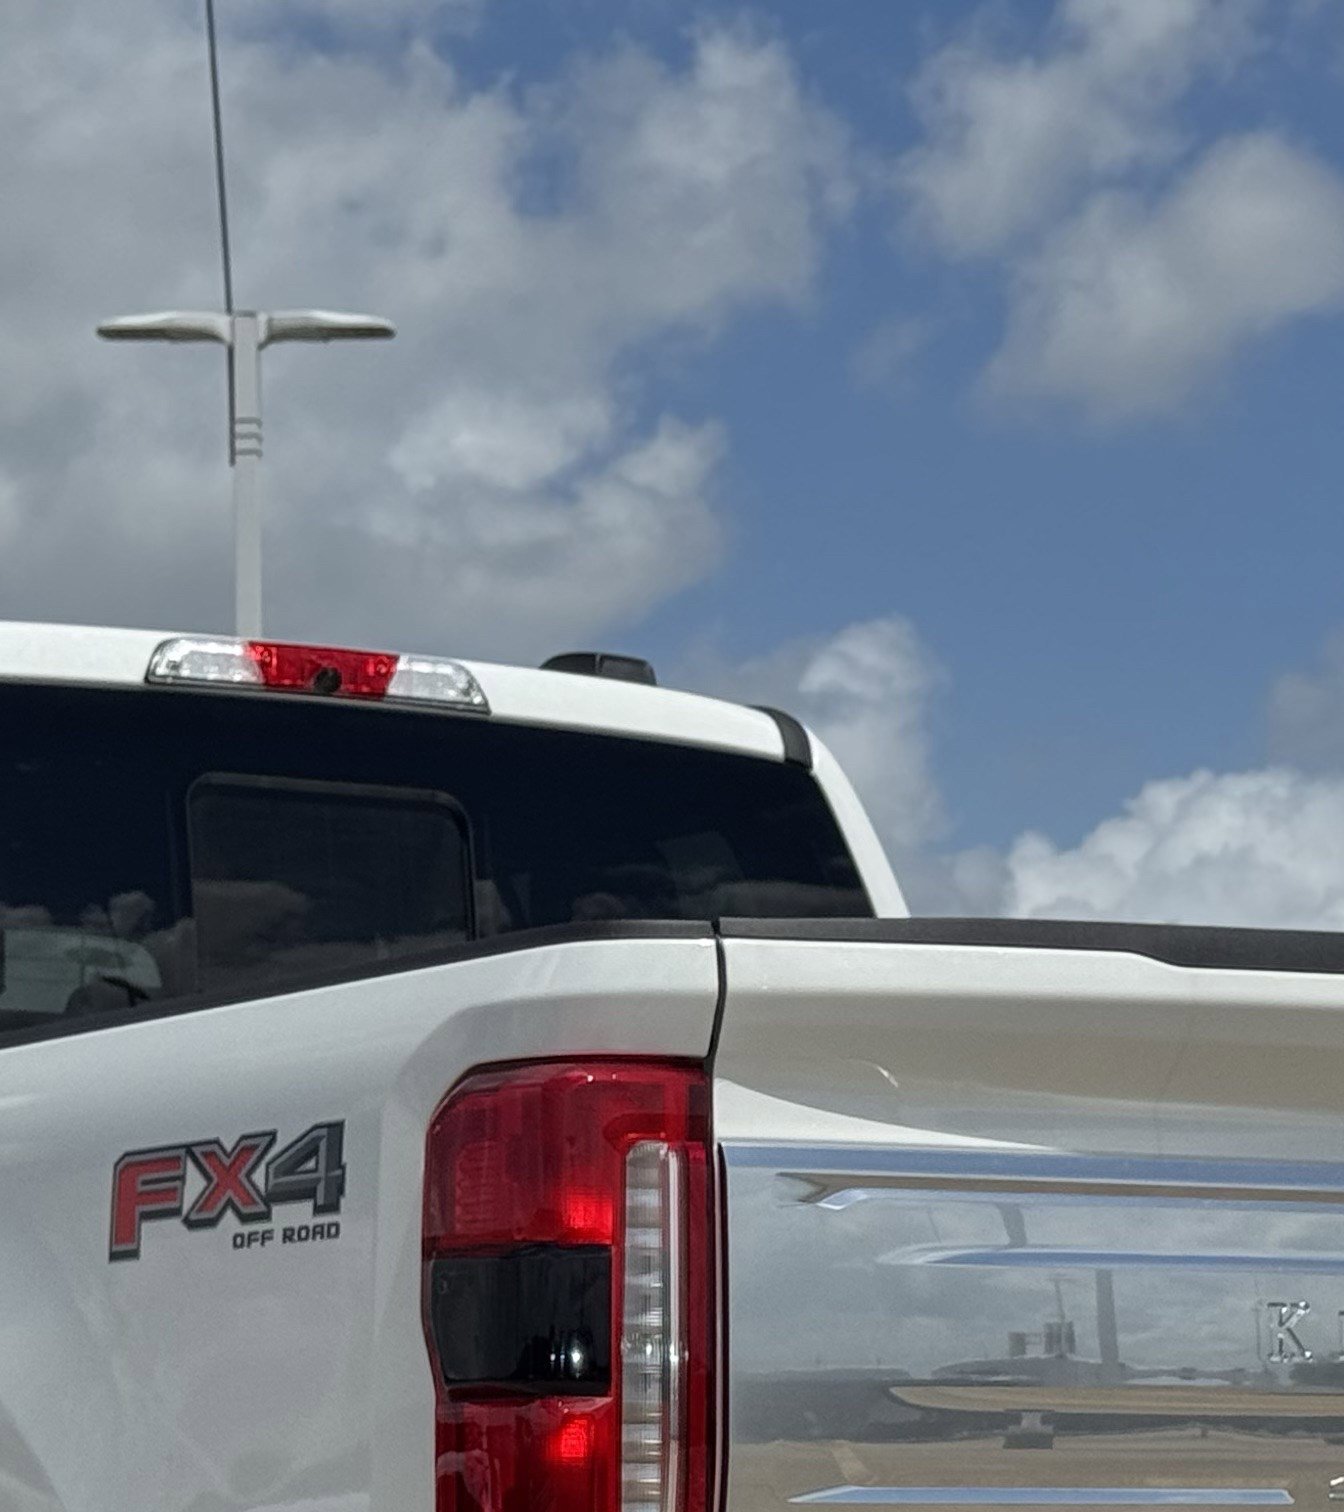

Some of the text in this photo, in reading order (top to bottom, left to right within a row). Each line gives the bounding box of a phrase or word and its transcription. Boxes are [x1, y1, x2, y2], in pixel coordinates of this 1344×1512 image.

[109, 1119, 346, 1263] FX4
[232, 1221, 341, 1250] OFF ROAD
